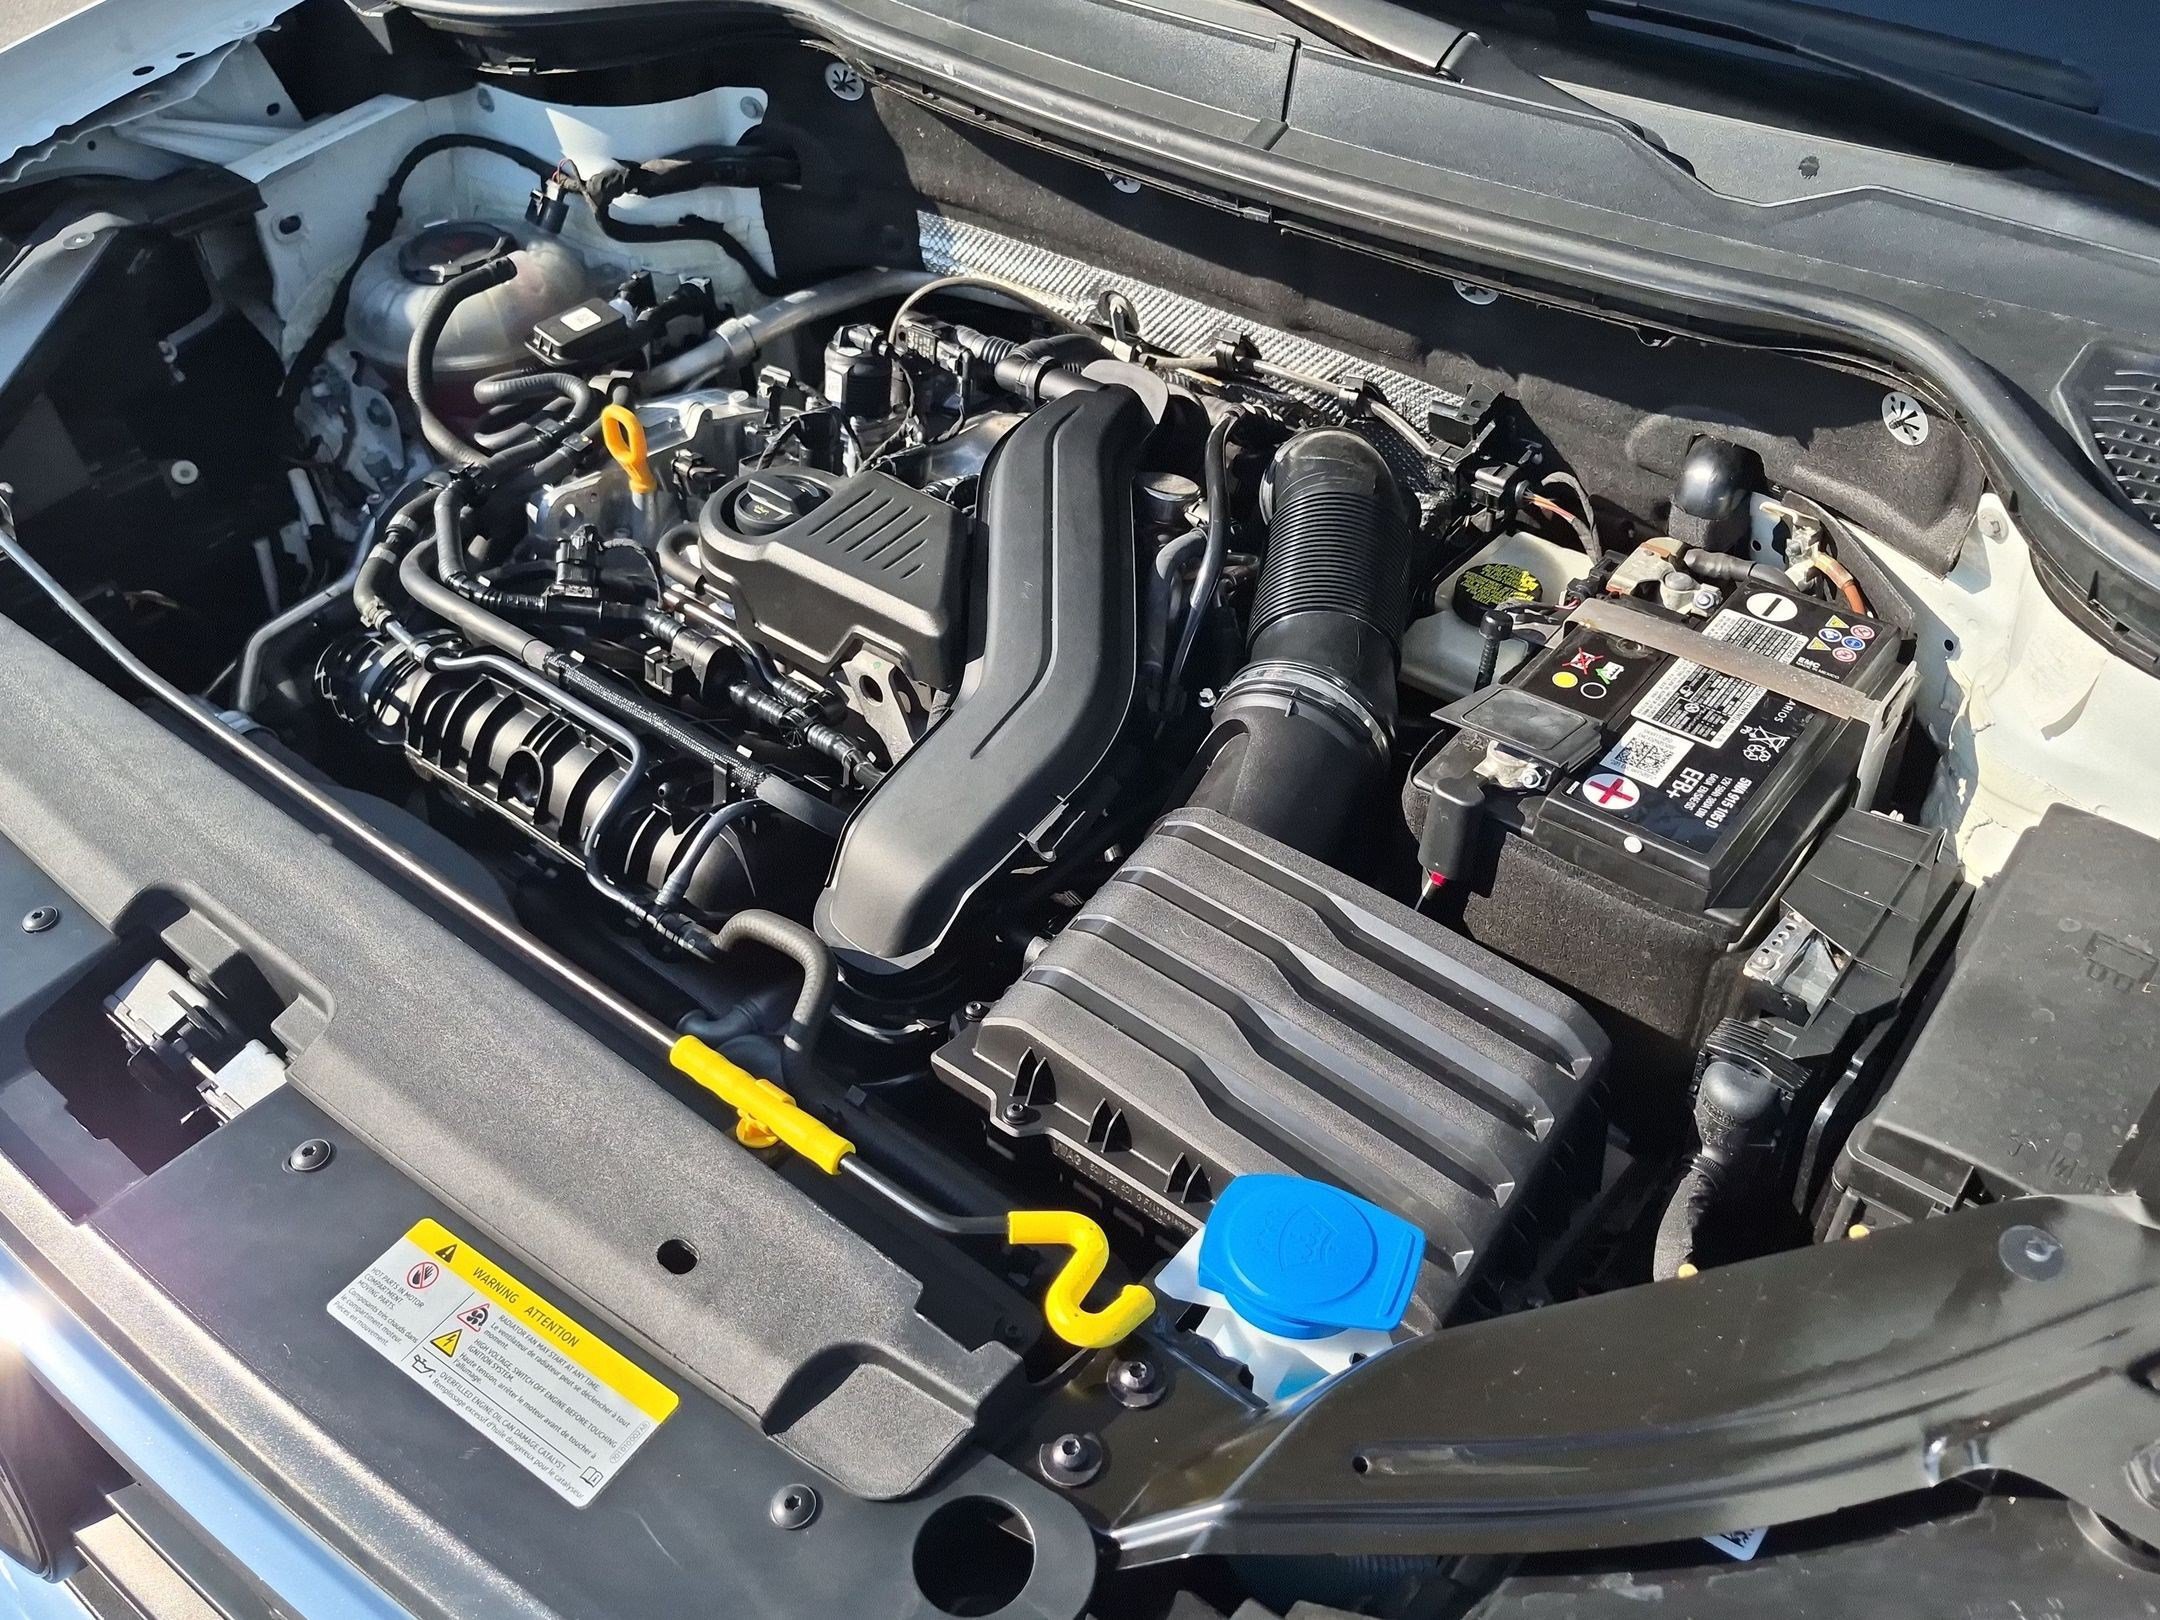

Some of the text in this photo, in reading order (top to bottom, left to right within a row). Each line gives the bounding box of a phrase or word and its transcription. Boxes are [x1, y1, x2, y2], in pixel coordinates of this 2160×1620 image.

[1773, 699, 1797, 723] ARIOS
[1740, 725, 1753, 735] Pb
[1663, 767, 1704, 802] EFB+
[1720, 776, 1733, 786] 12V
[1731, 777, 1753, 795] 5WA
[1709, 806, 1729, 822] 105
[1720, 792, 1741, 808] 915
[357, 1280, 379, 1297] MOVING
[371, 1267, 383, 1277] HOT
[382, 1275, 400, 1289] PARTS
[404, 1292, 425, 1308] MOTOR
[345, 1299, 383, 1329] compartiment
[381, 1327, 403, 1344] moteur.
[348, 1288, 419, 1343] Composants très chauds dans
[472, 1267, 580, 1348] WARNING ATTENTION
[356, 1320, 390, 1346] mouvement.
[484, 1330, 510, 1350] moment.
[499, 1315, 527, 1337] RADIATOR
[525, 1334, 538, 1345] FAN
[536, 1343, 550, 1354] MAY
[548, 1352, 566, 1366] START
[572, 1369, 586, 1380] ANY
[468, 1345, 493, 1365] IGNITION
[491, 1323, 500, 1331] Le
[498, 1329, 528, 1352] ventilateur
[527, 1350, 536, 1358] de
[535, 1356, 561, 1376] radiateur
[559, 1375, 574, 1387] peut
[581, 1390, 612, 1414] déclencher
[616, 1416, 630, 1428] tout
[440, 1372, 473, 1399] OVERFILLED
[472, 1397, 493, 1414] ENGINE
[492, 1412, 504, 1422] OIL
[502, 1420, 515, 1431] CAN
[514, 1429, 539, 1449] DAMAGE
[459, 1353, 478, 1368] Haute
[476, 1366, 499, 1385] tension,
[498, 1382, 519, 1399] arrêter
[523, 1402, 545, 1420] moteur
[544, 1418, 561, 1432] avant
[560, 1430, 570, 1438] de
[568, 1436, 592, 1455] toucher
[474, 1339, 489, 1351] HIGH
[512, 1367, 535, 1385] SWITCH
[533, 1383, 546, 1394] OFF
[544, 1391, 567, 1410] ENGINE
[565, 1407, 589, 1426] BEFORE
[587, 1424, 618, 1448] TOUCHING
[432, 1379, 468, 1408] Remplissage
[465, 1405, 488, 1423] excessif
[487, 1421, 507, 1438] d'huile
[505, 1436, 536, 1460] dangereux
[534, 1459, 549, 1472] pour
